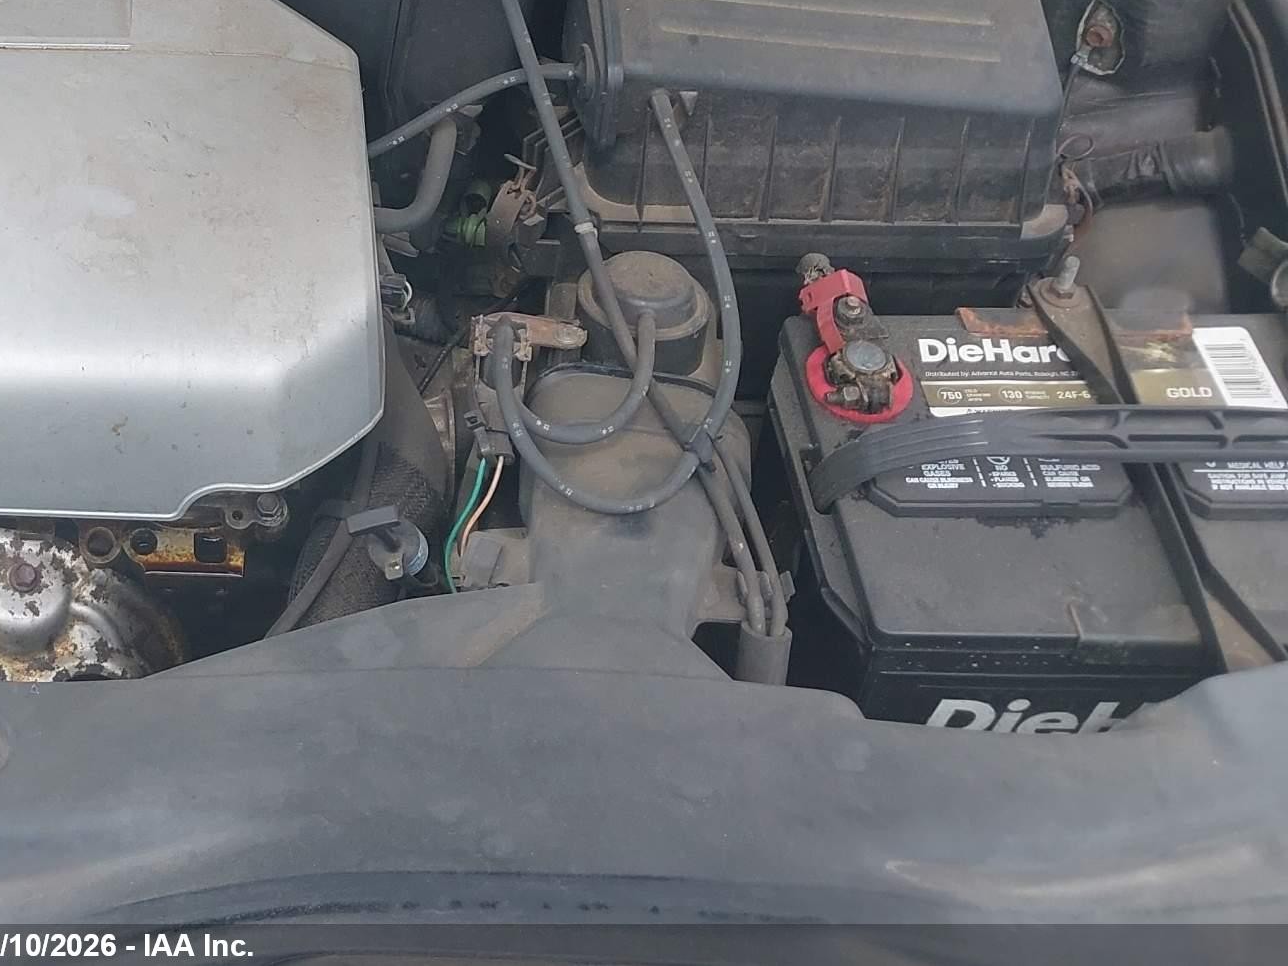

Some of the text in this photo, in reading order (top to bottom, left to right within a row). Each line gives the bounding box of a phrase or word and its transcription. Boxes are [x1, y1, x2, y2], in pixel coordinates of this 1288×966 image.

[940, 391, 963, 400] 750
[1001, 390, 1024, 399] 130
[1166, 387, 1212, 398] GOLD
